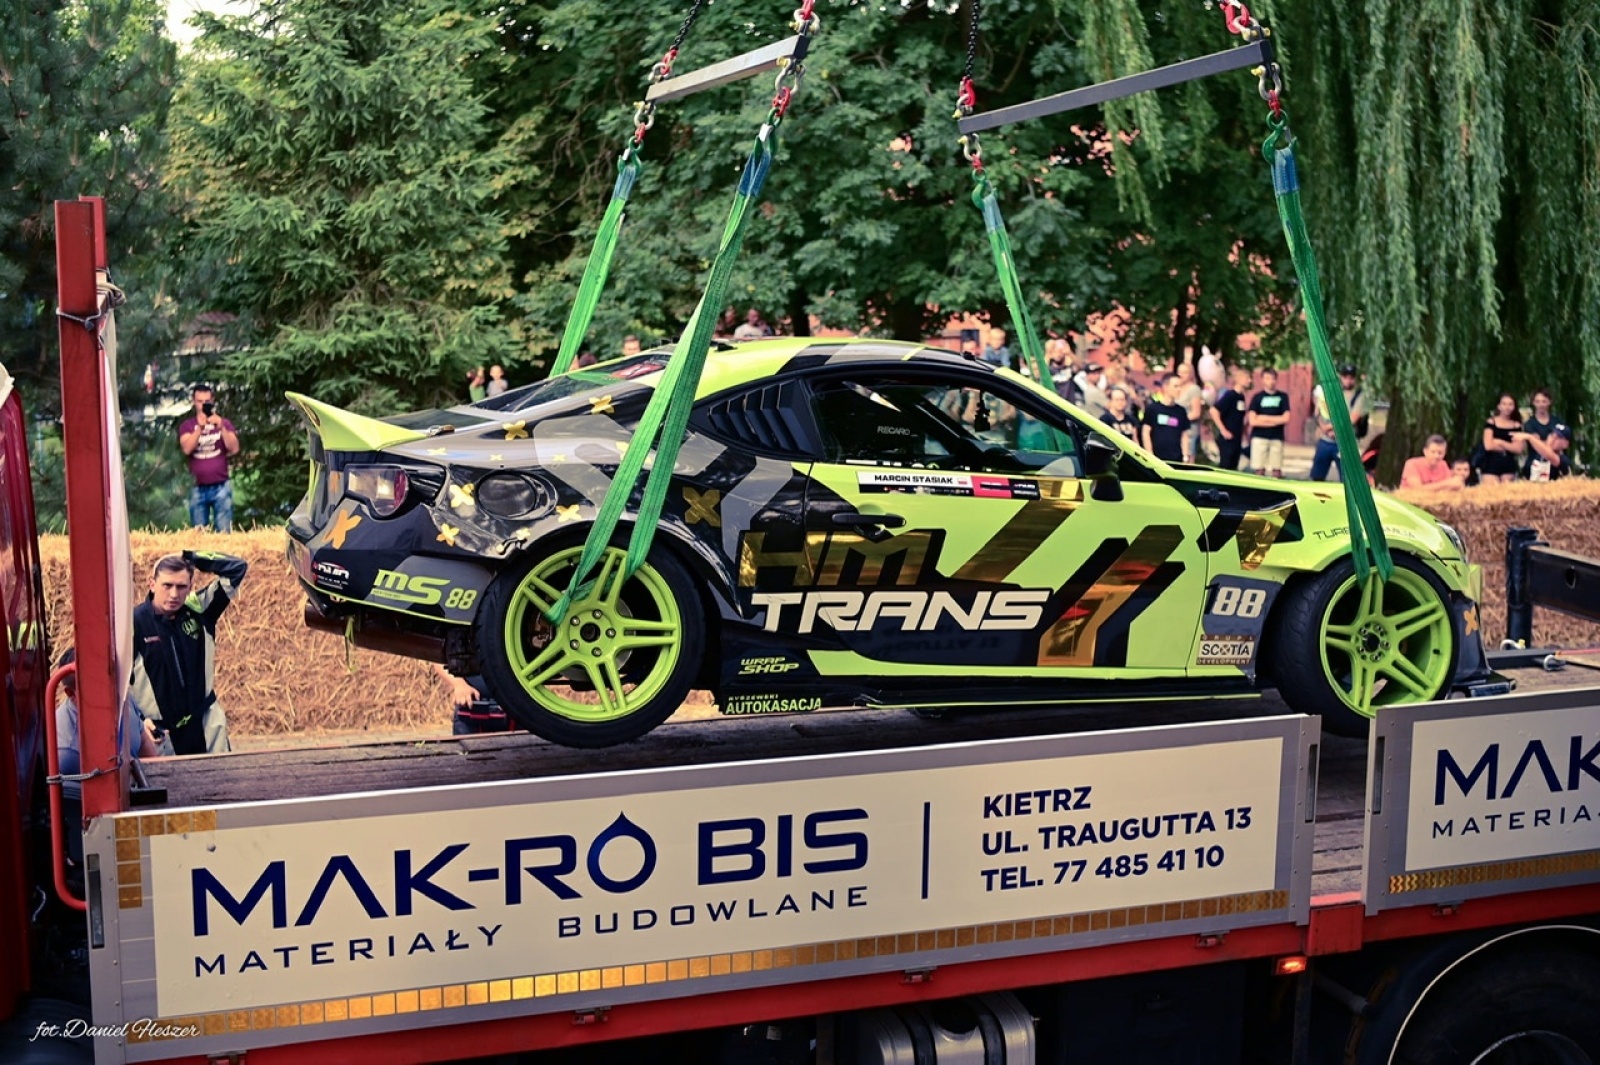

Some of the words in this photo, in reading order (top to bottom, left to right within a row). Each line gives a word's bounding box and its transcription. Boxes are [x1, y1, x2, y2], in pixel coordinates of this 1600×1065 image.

[874, 474, 911, 483] MARCIN
[912, 476, 954, 485] STASIAK
[444, 588, 478, 610] 88
[750, 590, 1053, 634] TRANS
[738, 663, 800, 675] SHOP
[740, 657, 786, 666] WRAP
[725, 698, 822, 715] AUTOKASACJA
[983, 786, 1092, 819] KIETRZ
[982, 830, 1029, 856] UL.
[1038, 810, 1216, 850] TRAUGUTTA
[1224, 806, 1252, 831] 13
[1432, 804, 1600, 839] MATERIA
[192, 811, 656, 937] MAK-RO
[697, 808, 869, 886] BIS
[981, 865, 1044, 892] TEL.
[1053, 860, 1088, 885] 77
[1095, 853, 1149, 879] 485
[1156, 849, 1186, 872] 41
[1194, 845, 1225, 869] 10
[194, 924, 503, 978] MATERIAŁY
[558, 885, 868, 938] BUDOWLANE
